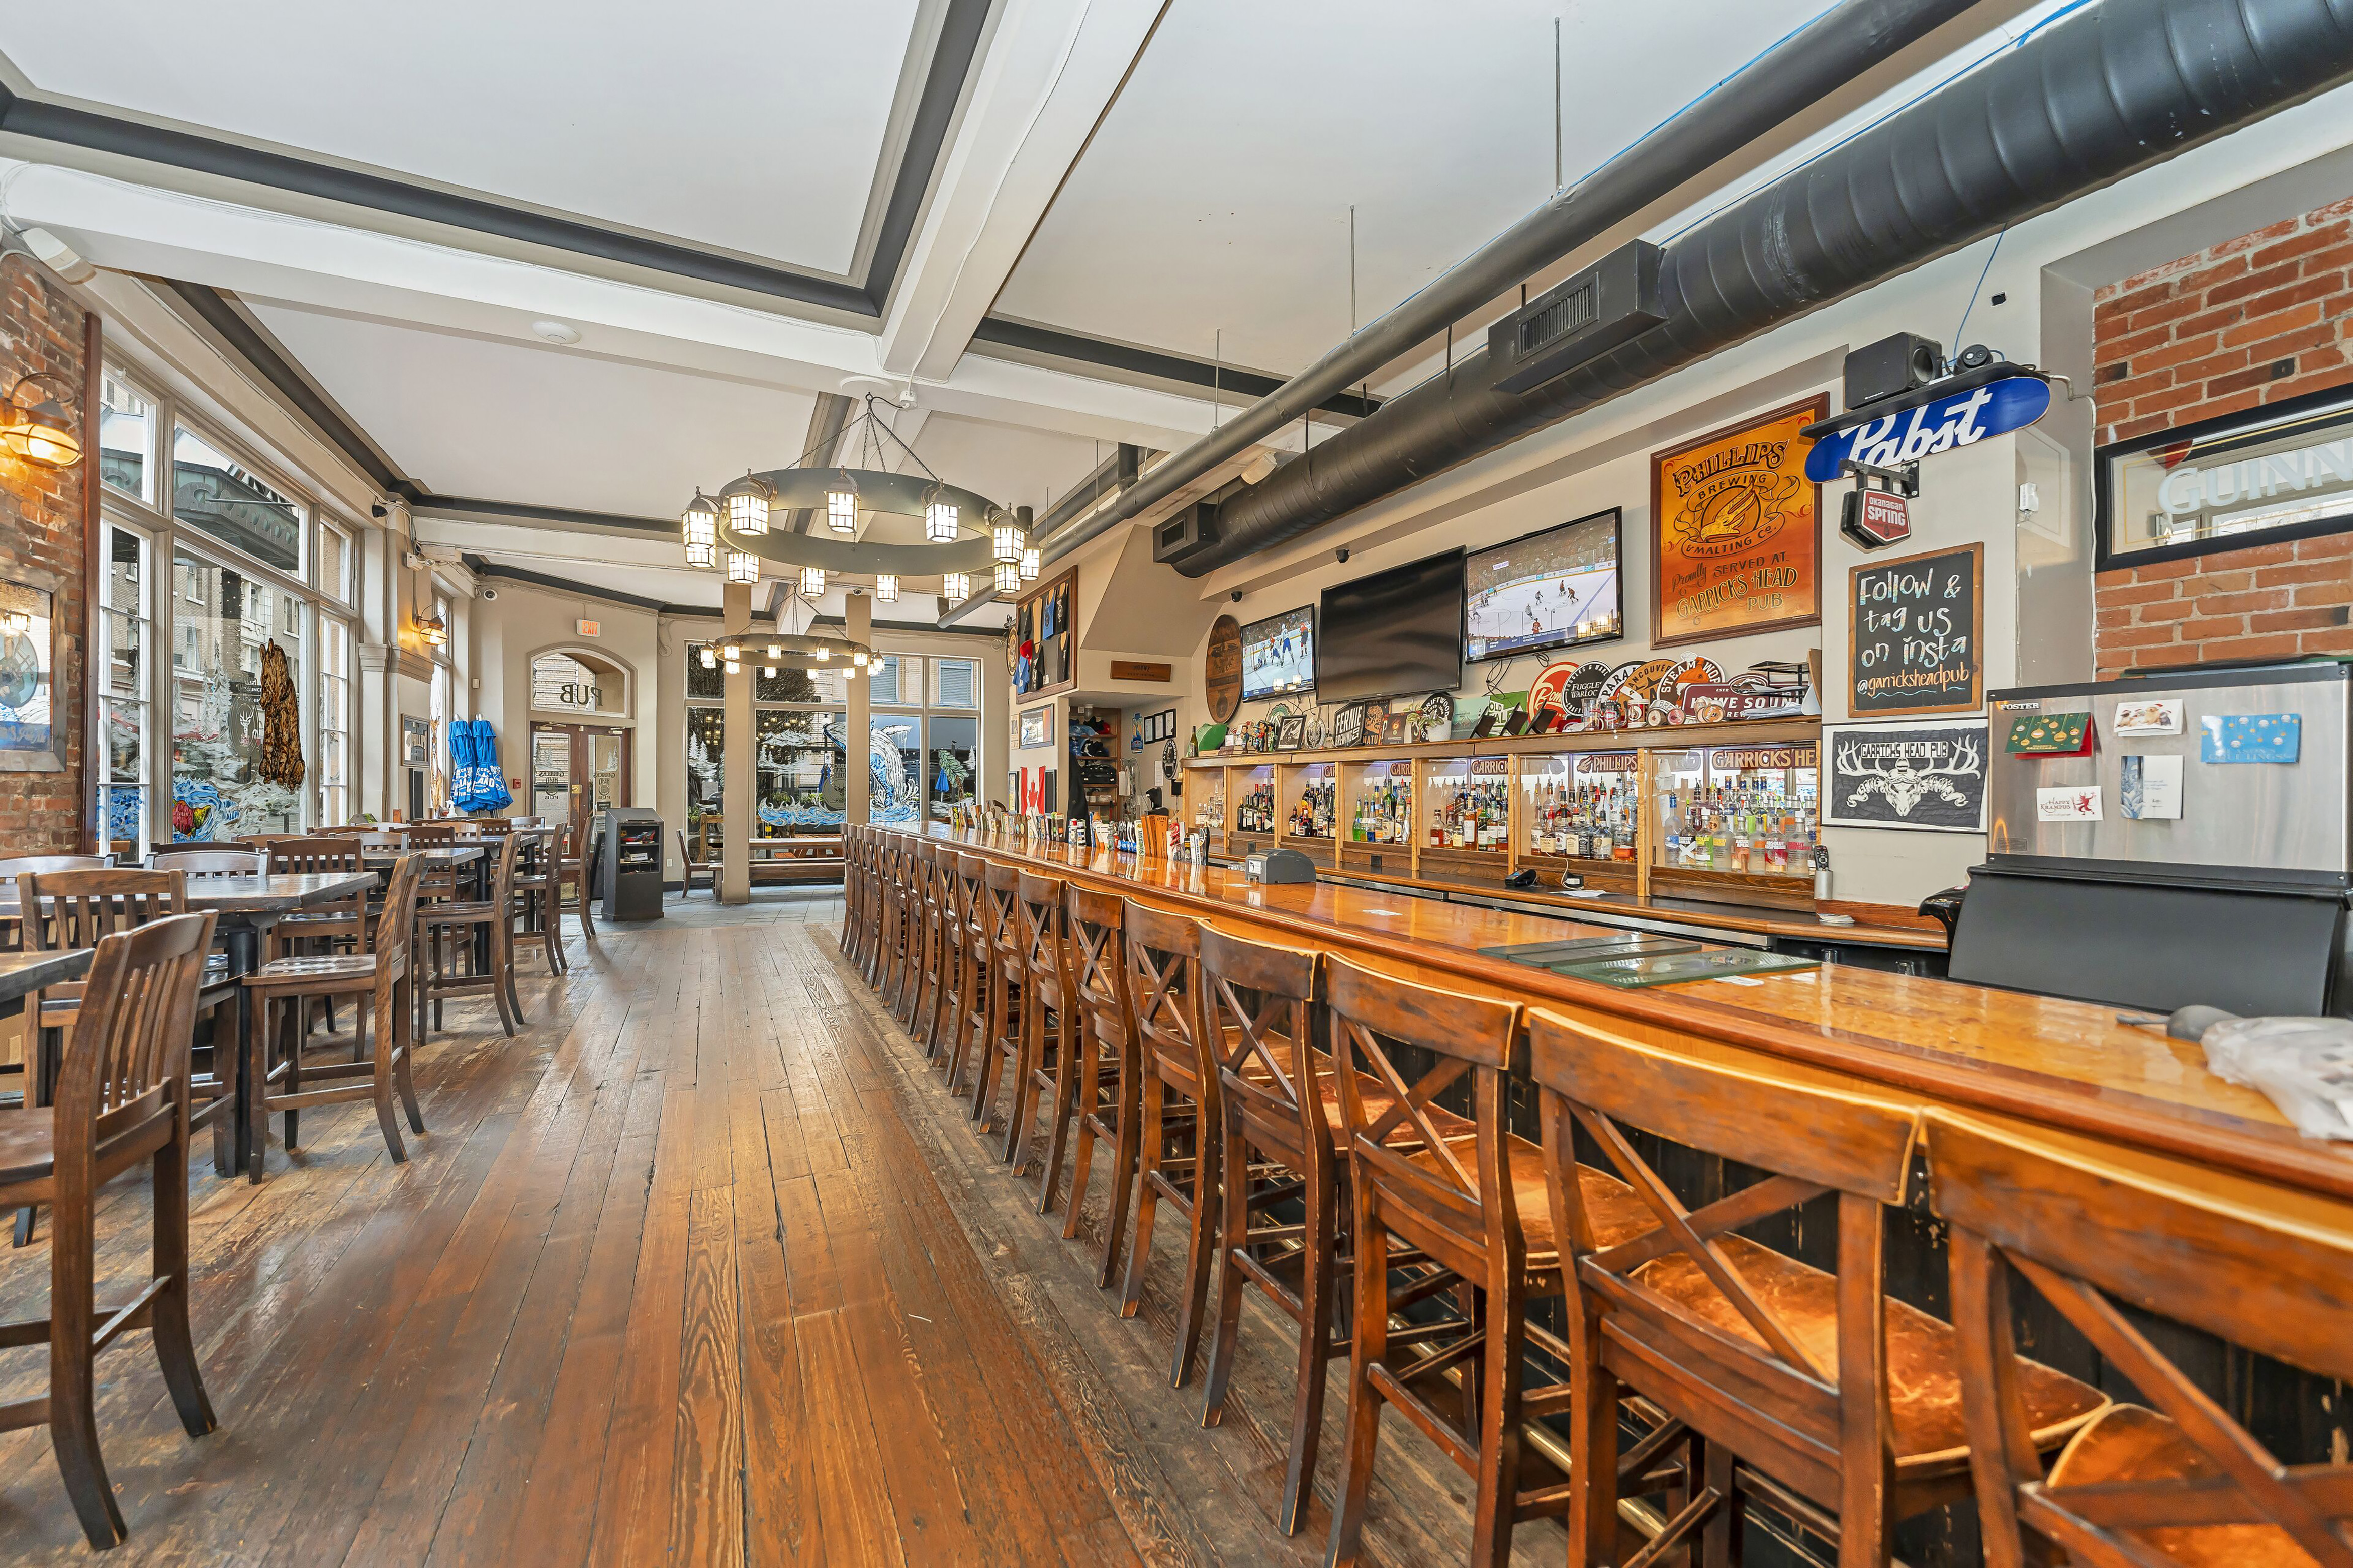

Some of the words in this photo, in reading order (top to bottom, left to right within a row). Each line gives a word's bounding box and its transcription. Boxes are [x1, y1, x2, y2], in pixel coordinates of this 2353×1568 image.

[1838, 387, 1993, 478] Pabst
[1672, 439, 1790, 497] PHILLIPS
[1698, 474, 1767, 499] BREWING
[1712, 557, 1765, 578] SERVED
[1751, 566, 1798, 590] HEAD
[1860, 568, 1933, 605] Follow
[1943, 574, 1962, 598] &
[1747, 592, 1783, 612] PUB
[582, 621, 598, 635] EXIT
[1863, 607, 1907, 632] tag
[1861, 642, 1889, 667] on
[1903, 636, 1967, 668] insta
[1571, 681, 1602, 691] FUGGLE
[1661, 660, 1696, 692] STEAM
[1857, 661, 1970, 697] @garricksheadpub
[1571, 689, 1598, 698] WARLOC
[1423, 697, 1450, 716] DRIFTWOOD
[1489, 702, 1502, 712] OLD
[1336, 706, 1363, 735] FERNIE
[1795, 749, 1816, 767] HE
[1904, 743, 1925, 757] HEAD
[1931, 742, 1947, 757] PUB
[1592, 755, 1637, 772] PHILLIPS
[2040, 804, 2070, 813] KRAMPUS
